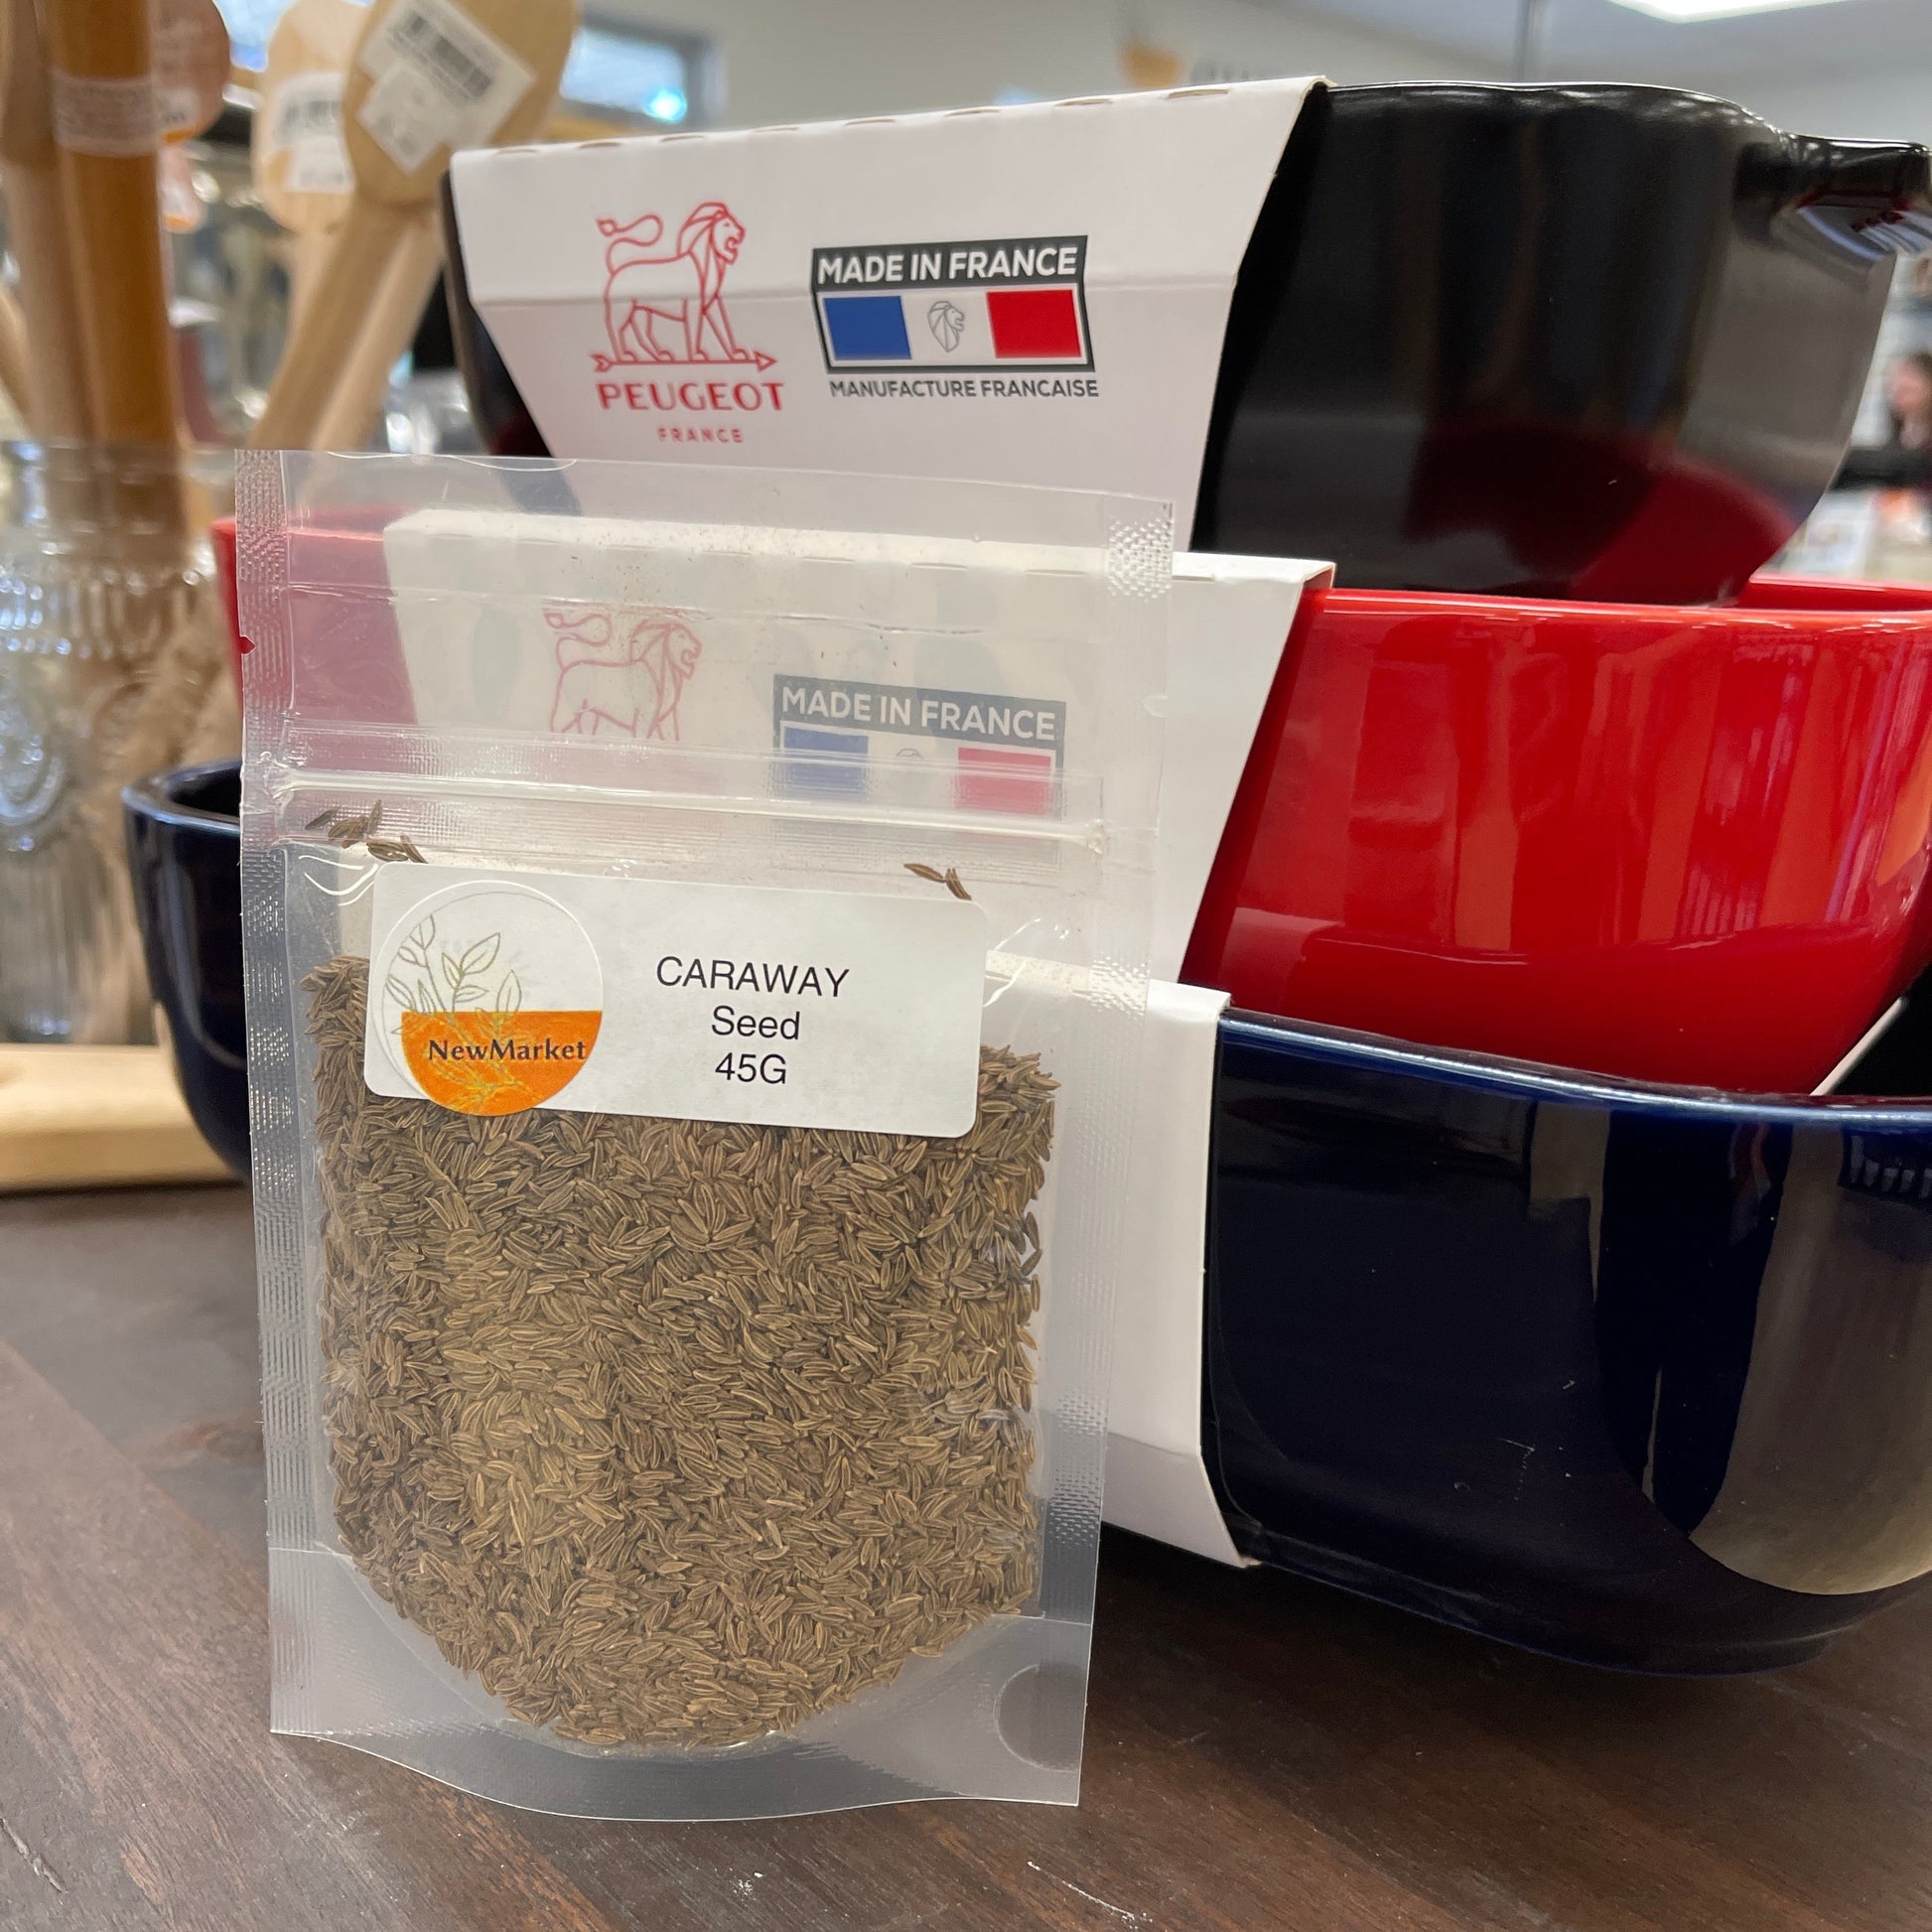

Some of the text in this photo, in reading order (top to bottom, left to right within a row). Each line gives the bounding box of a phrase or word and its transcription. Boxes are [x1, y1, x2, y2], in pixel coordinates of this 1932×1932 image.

[817, 246, 1079, 285] MADE IN FRANCE
[596, 381, 785, 412] PEUGEOT
[829, 379, 1099, 398] MANUFACTURE FRANCAISE
[657, 427, 744, 444] FRANCE
[782, 686, 1056, 741] MADE IN FRANCE
[656, 956, 850, 998] CARAWAY
[711, 1005, 800, 1040] Seed
[429, 1037, 587, 1060] NewMarket
[715, 1051, 786, 1084] 45G
